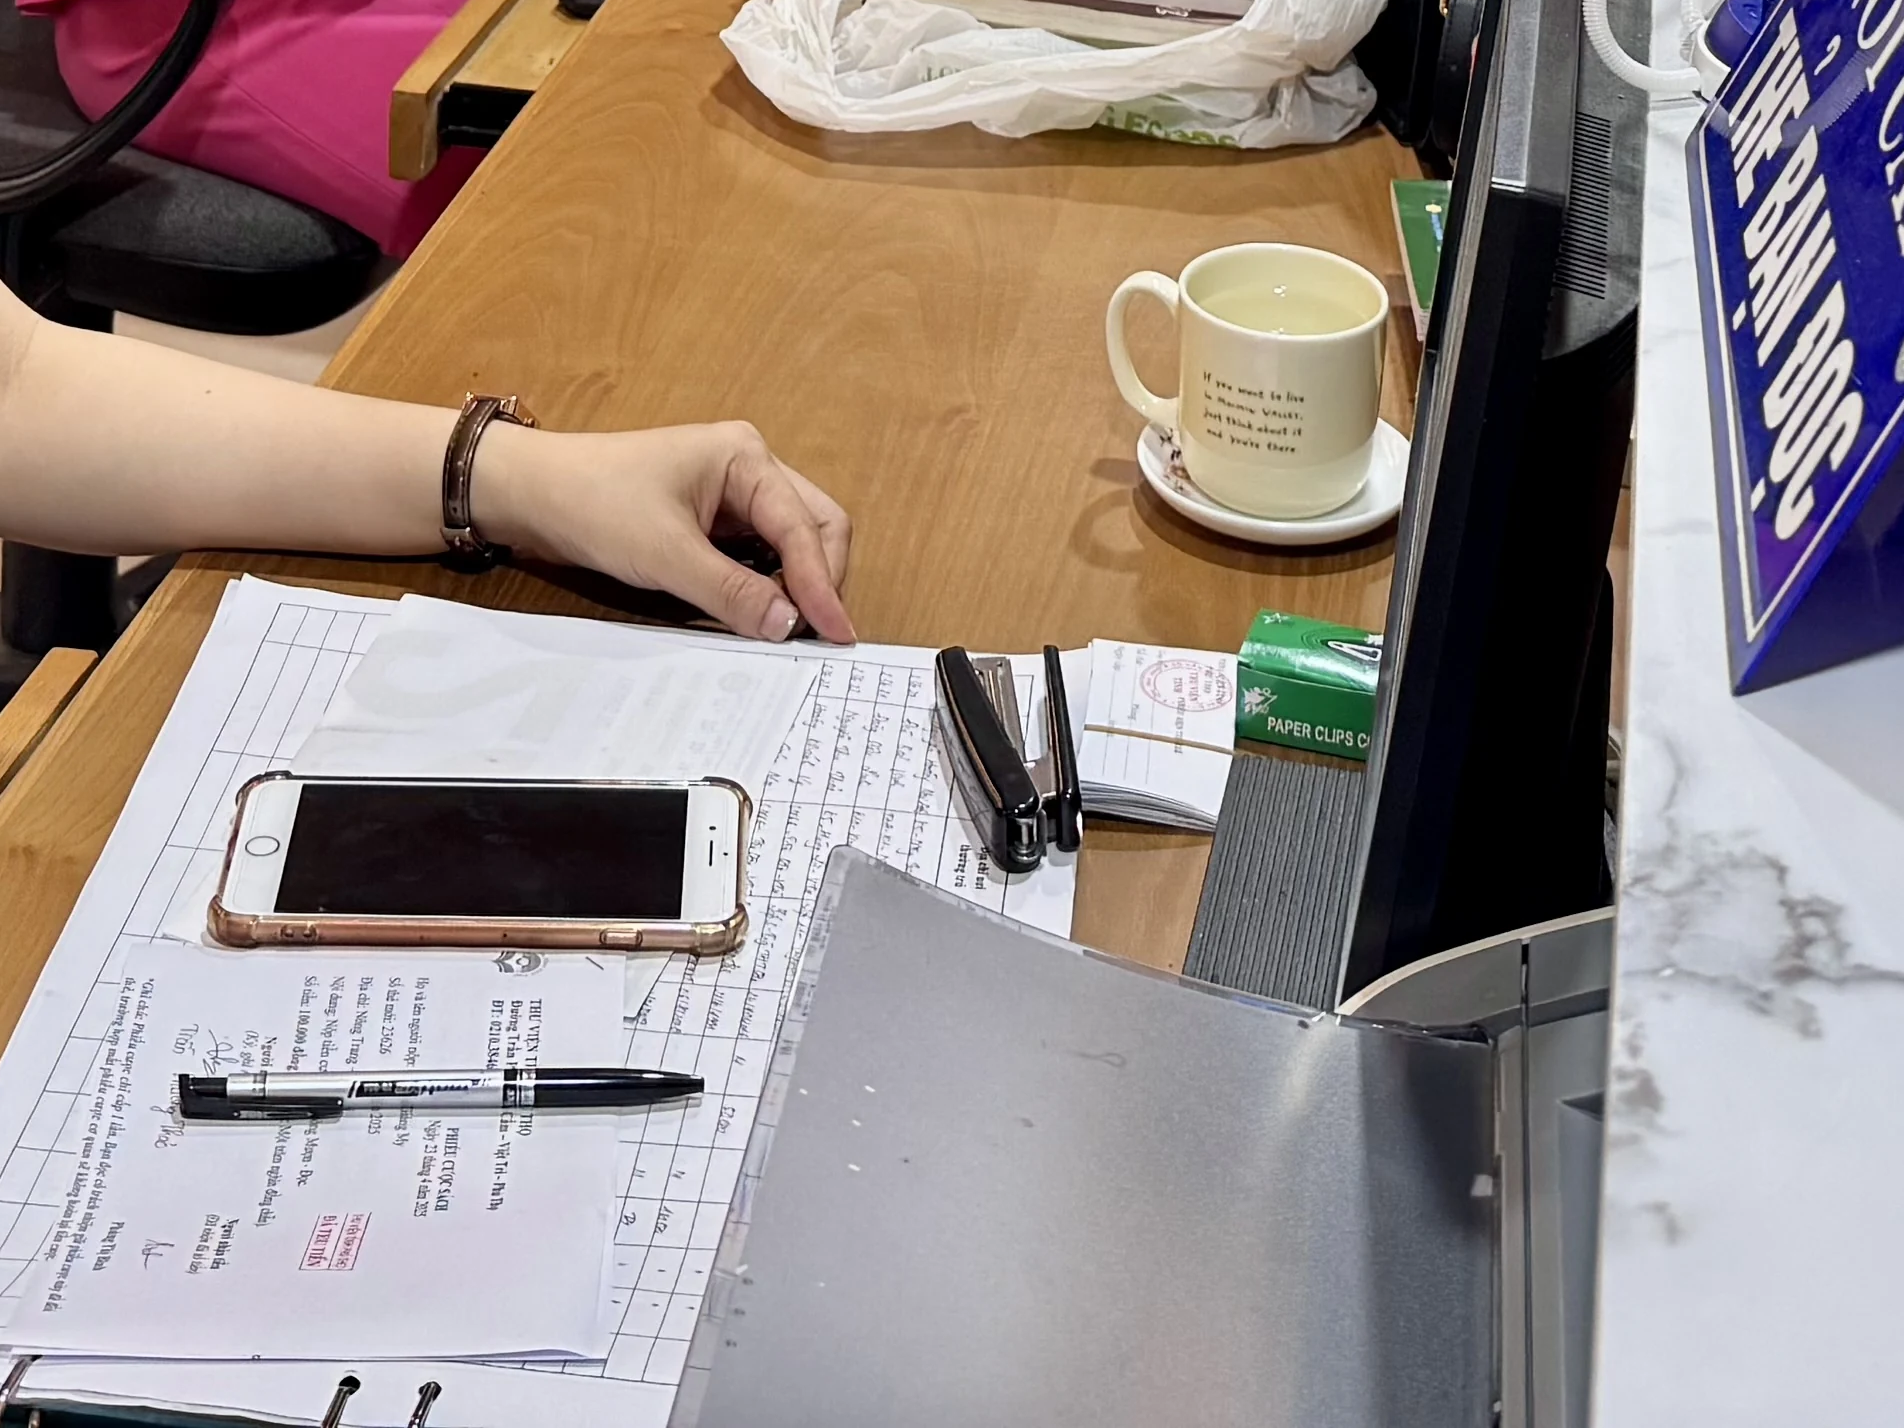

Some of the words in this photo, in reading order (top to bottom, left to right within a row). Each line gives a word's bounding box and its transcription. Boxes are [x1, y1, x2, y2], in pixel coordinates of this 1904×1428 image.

[1732, 124, 1836, 368] BẠN
[1750, 279, 1864, 541] ĐỌC
[1267, 716, 1312, 739] PAPER
[1315, 725, 1354, 747] CLIPS
[1358, 733, 1371, 748] C
[304, 976, 319, 987] Số
[329, 976, 345, 991] Nội
[357, 977, 373, 990] Địa
[388, 977, 405, 987] Số
[415, 977, 429, 989] Họ
[300, 989, 317, 1007] tiền:
[386, 990, 400, 1001] thẻ
[415, 991, 427, 1001] và
[110, 995, 130, 1026] trường
[412, 1003, 425, 1015] tên
[491, 1000, 504, 1018] ĐT:
[506, 1000, 523, 1032] Đường
[528, 999, 544, 1023] THƯ
[294, 1010, 311, 1044] 100.000
[320, 1019, 338, 1038] Nộp
[350, 1011, 368, 1034] Nông
[408, 1018, 422, 1044] người
[106, 1028, 125, 1046] hợp
[128, 1023, 146, 1049] Phiếu
[379, 1026, 394, 1055] 23626
[507, 1034, 522, 1058] Trần
[524, 1025, 540, 1052] VIỆN
[104, 1048, 122, 1065] mất
[260, 1036, 277, 1067] Người
[320, 1040, 338, 1058] tiền
[345, 1037, 364, 1064] Trang
[121, 1051, 135, 1075] cược
[98, 1067, 115, 1094] phiếu
[89, 1096, 106, 1121] cược
[110, 1094, 131, 1112] cấp
[88, 1123, 99, 1135] cơ
[368, 1113, 382, 1134] 2025
[423, 1120, 441, 1142] Ngày
[81, 1136, 94, 1159] quan
[99, 1141, 118, 1159] Bạn
[300, 1137, 319, 1163] Mượn
[424, 1145, 437, 1154] 23
[444, 1127, 460, 1157] PHIẾU
[94, 1161, 111, 1178] đọc
[417, 1156, 437, 1176] tháng
[438, 1160, 456, 1188] CƯỢC
[66, 1172, 88, 1198] không
[93, 1178, 107, 1189] có
[296, 1170, 313, 1187] Đọc
[86, 1189, 103, 1210] trách
[259, 1188, 281, 1206] đồng
[416, 1185, 431, 1199] năm
[435, 1189, 454, 1211] SÁCH
